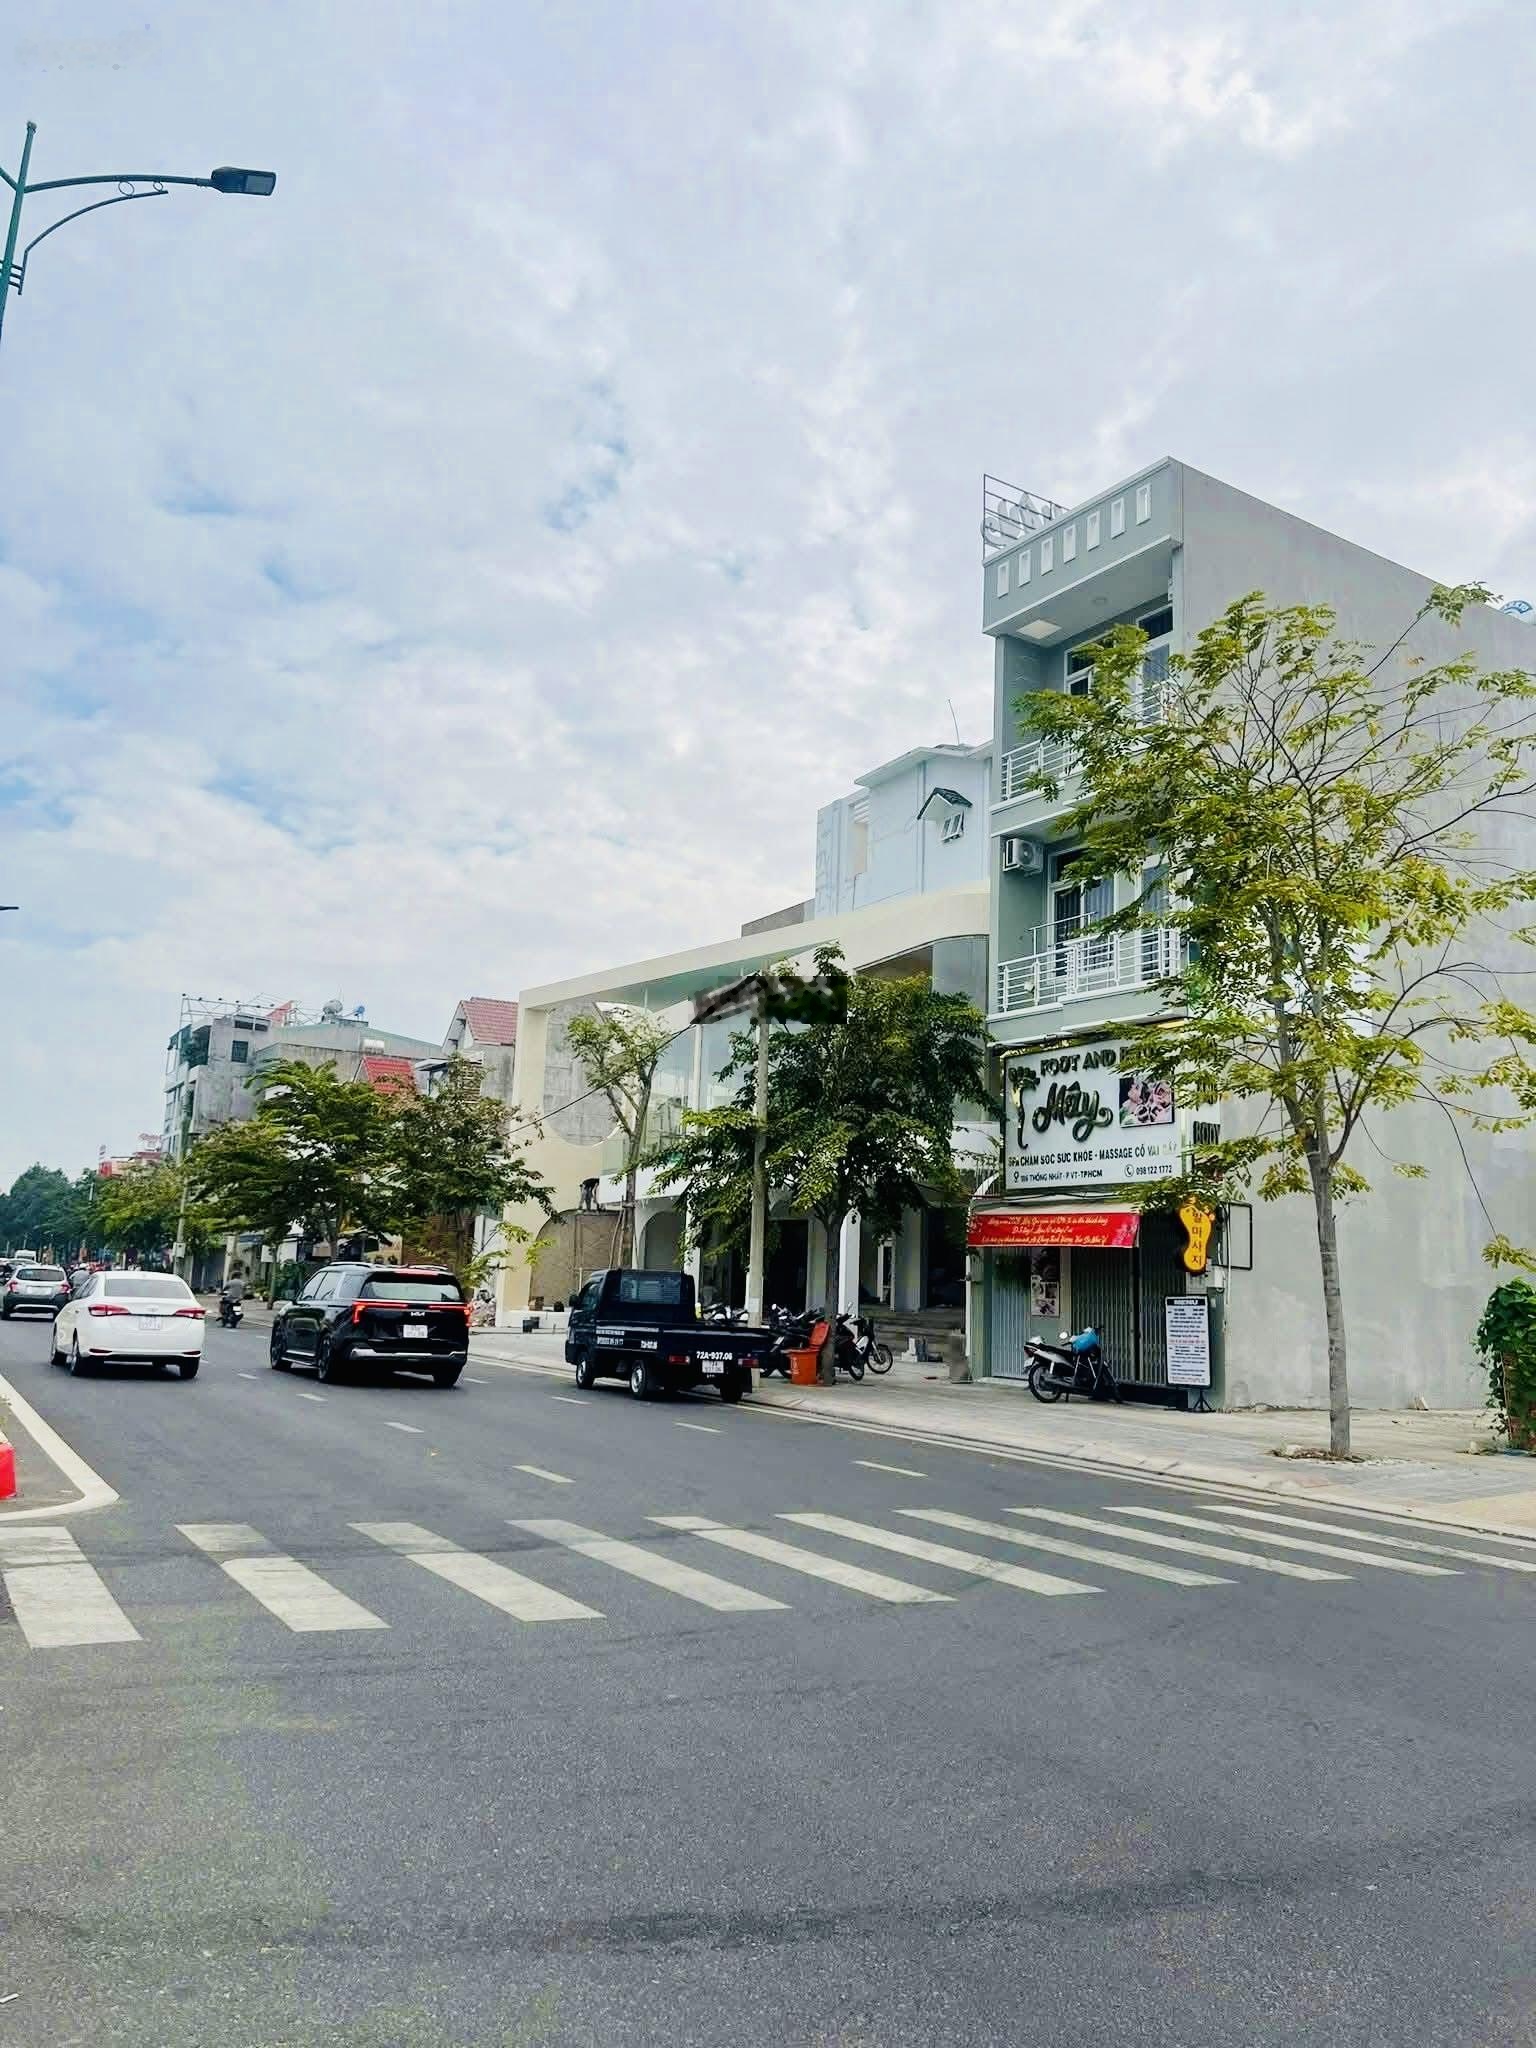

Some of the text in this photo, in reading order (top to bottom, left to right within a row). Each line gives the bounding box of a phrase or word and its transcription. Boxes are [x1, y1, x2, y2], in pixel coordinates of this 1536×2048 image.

[1040, 1054, 1080, 1077] FOOT
[1083, 1048, 1117, 1069] AND
[1193, 1120, 1221, 1145] BODY
[1099, 1147, 1133, 1160] MASSAGE
